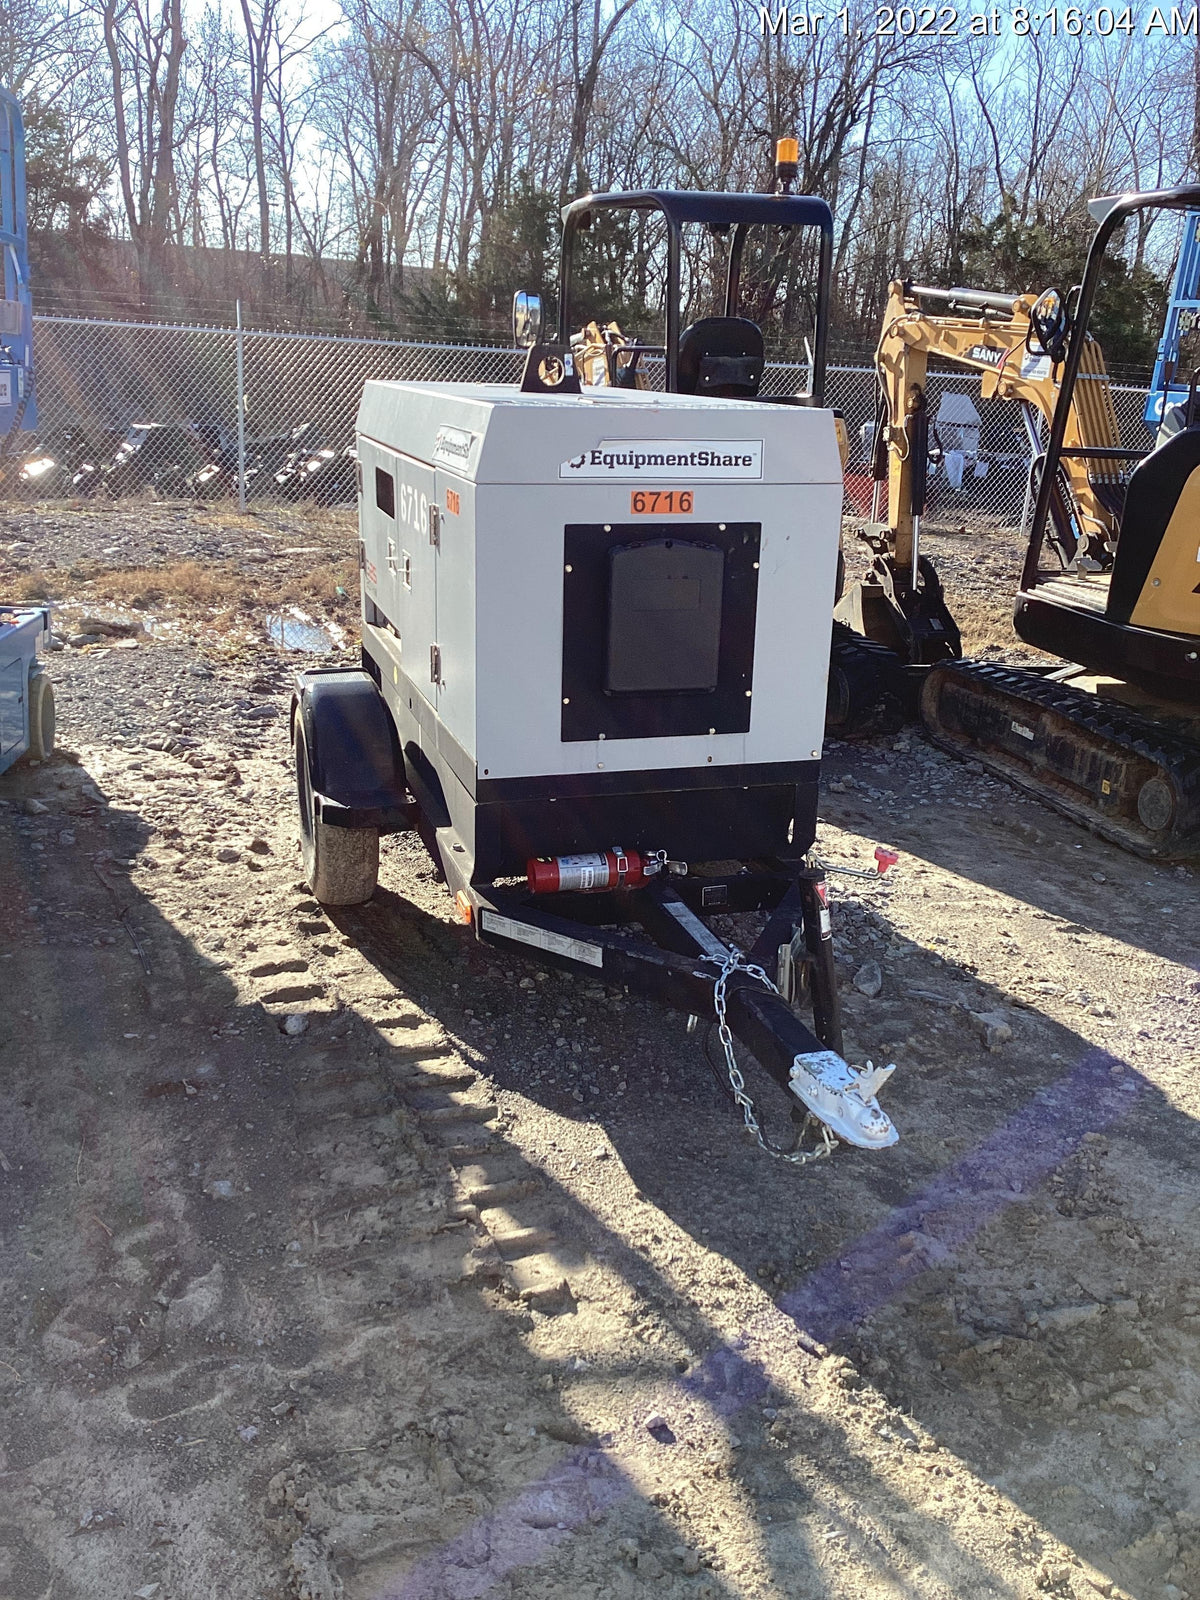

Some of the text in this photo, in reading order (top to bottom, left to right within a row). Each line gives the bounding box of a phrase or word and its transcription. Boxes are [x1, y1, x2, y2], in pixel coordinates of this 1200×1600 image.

[972, 346, 1002, 363] SANY
[590, 450, 753, 469] EquipmentShare
[400, 482, 427, 535] 6716
[446, 489, 460, 514] 6716
[633, 491, 692, 513] 6716
